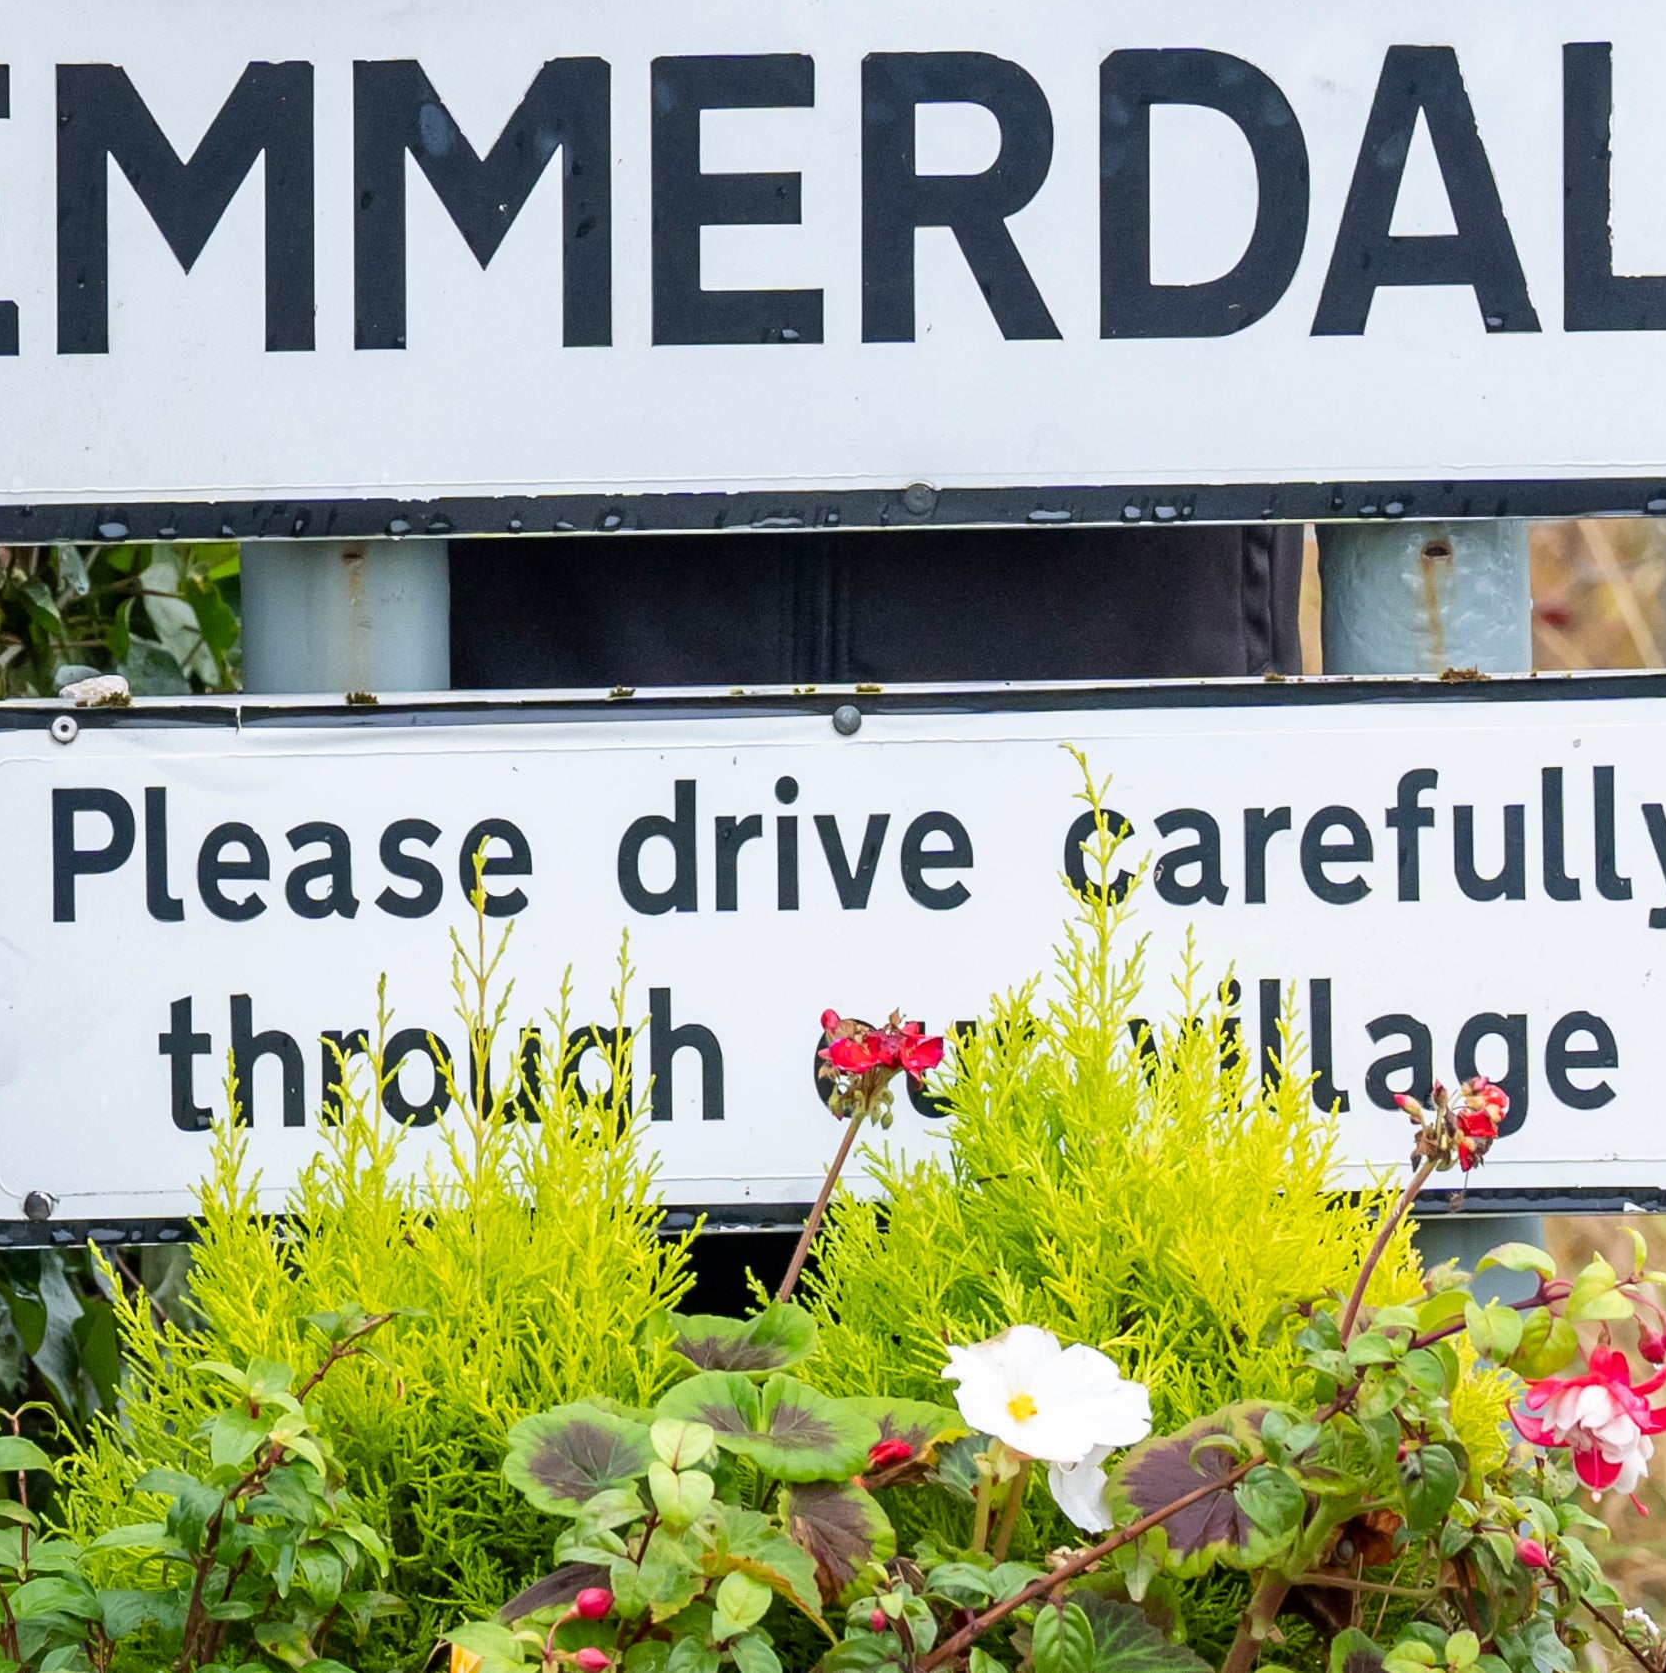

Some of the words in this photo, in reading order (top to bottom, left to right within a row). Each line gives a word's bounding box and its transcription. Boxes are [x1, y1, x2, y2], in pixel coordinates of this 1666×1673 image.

[51, 785, 533, 924] Please
[617, 775, 974, 916] drive
[158, 986, 726, 1152] through
